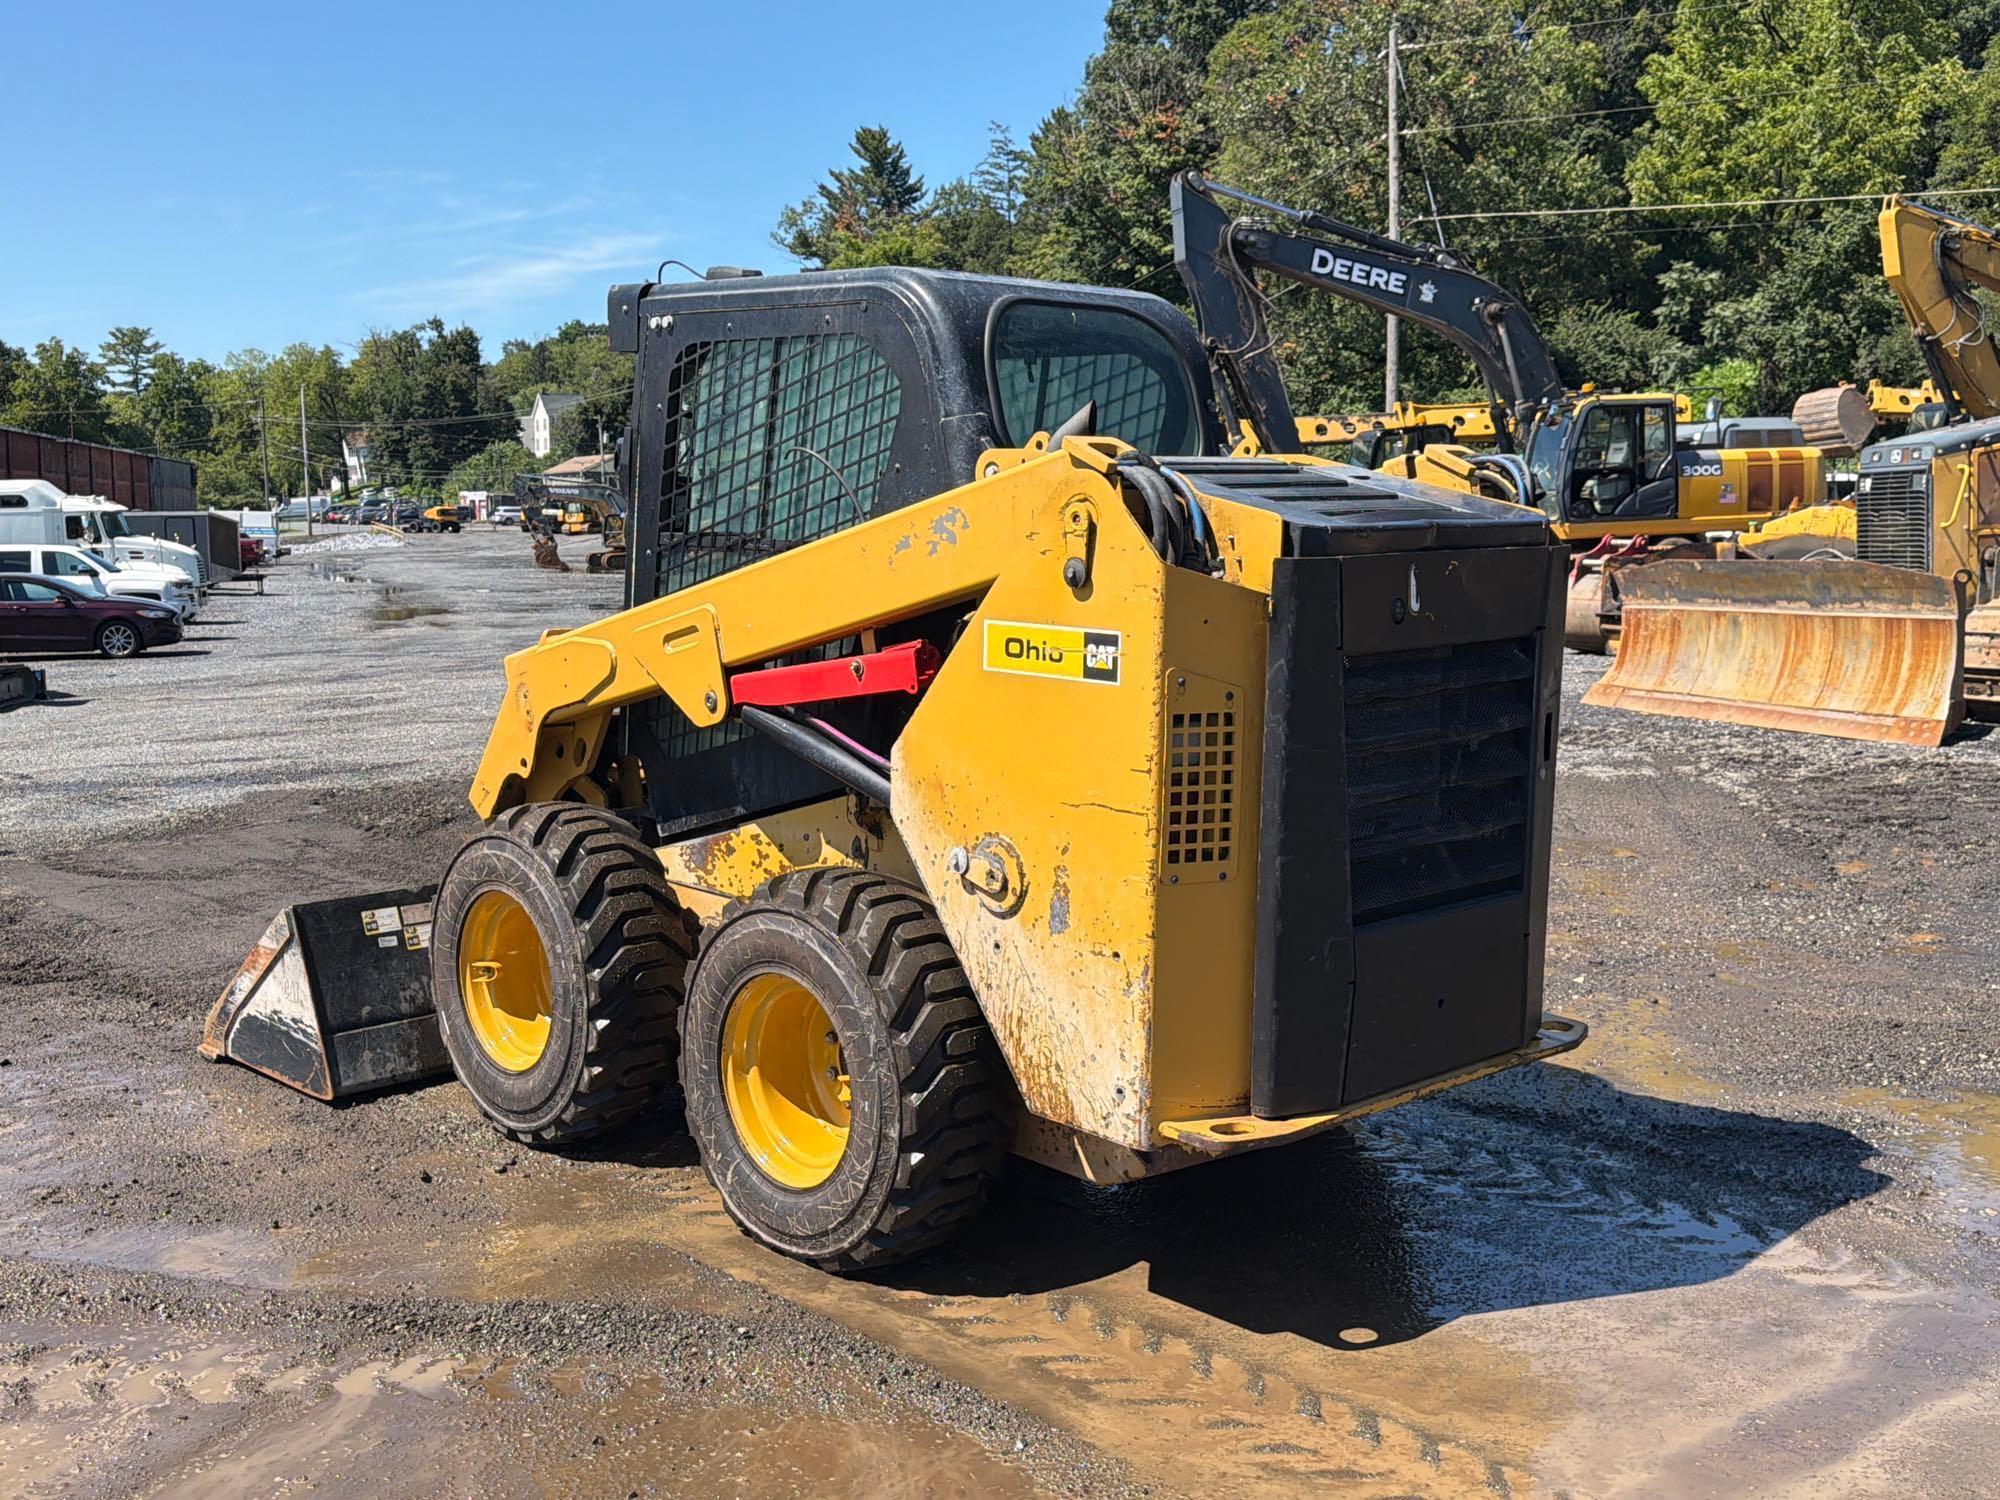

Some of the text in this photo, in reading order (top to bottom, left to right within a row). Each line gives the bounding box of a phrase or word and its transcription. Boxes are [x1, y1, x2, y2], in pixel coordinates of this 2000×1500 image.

[1310, 248, 1408, 295] DEERE
[1682, 464, 1721, 477] 300G
[548, 487, 579, 495] VOLVO
[1005, 637, 1117, 670] Ohio CAT
